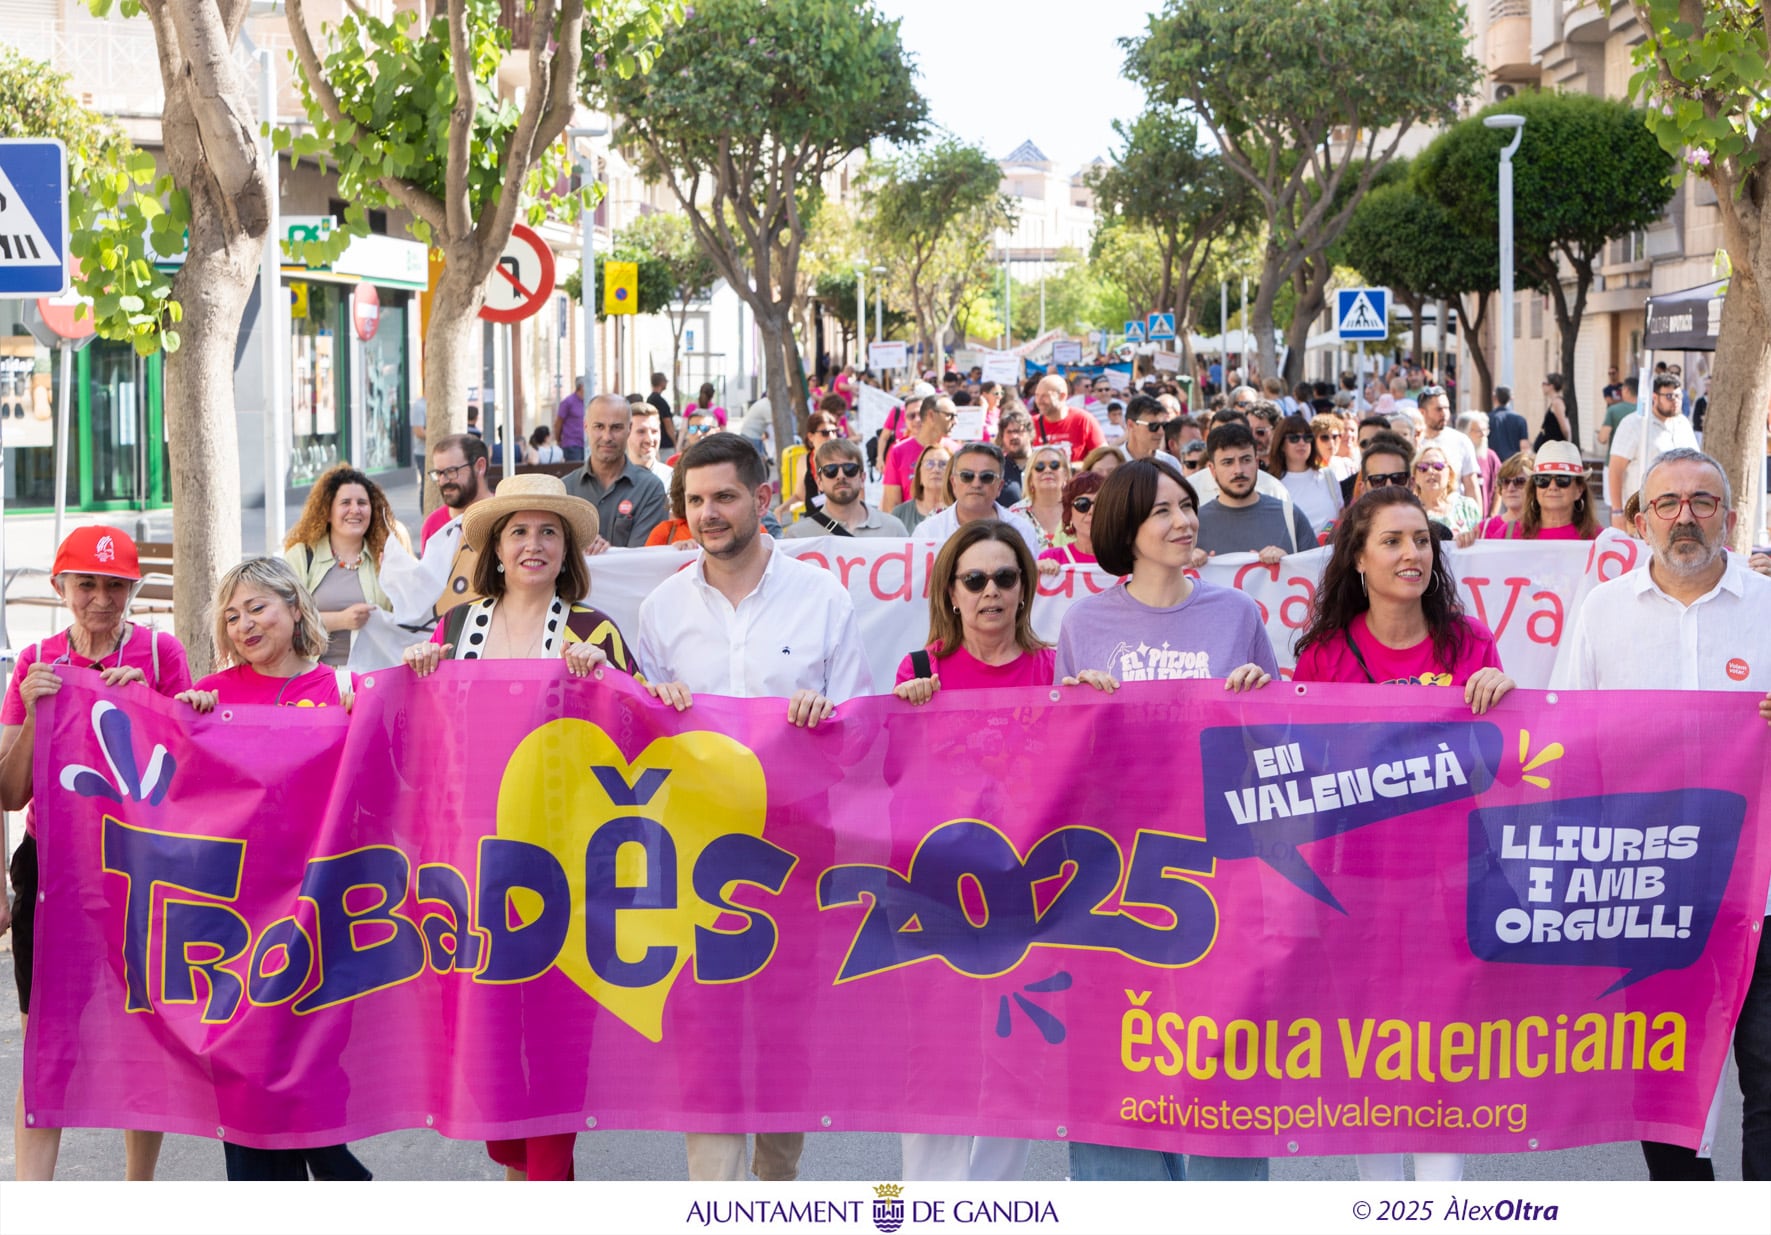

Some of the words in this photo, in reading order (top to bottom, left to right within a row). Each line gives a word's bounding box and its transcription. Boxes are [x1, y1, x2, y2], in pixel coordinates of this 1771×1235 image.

[1120, 651, 1144, 671] EL
[1149, 648, 1209, 670] PITJOR
[1253, 742, 1304, 778] EN
[1224, 742, 1468, 825] VALENCIÀ
[1501, 825, 1700, 862] LLIURES
[816, 818, 1219, 985] 2025
[1528, 867, 1553, 902] I
[1565, 866, 1665, 902] AMB
[1495, 905, 1694, 944] ORGULL!
[1338, 1011, 1687, 1082] valenciana
[1120, 1095, 1528, 1135] activistespelvalencia.org
